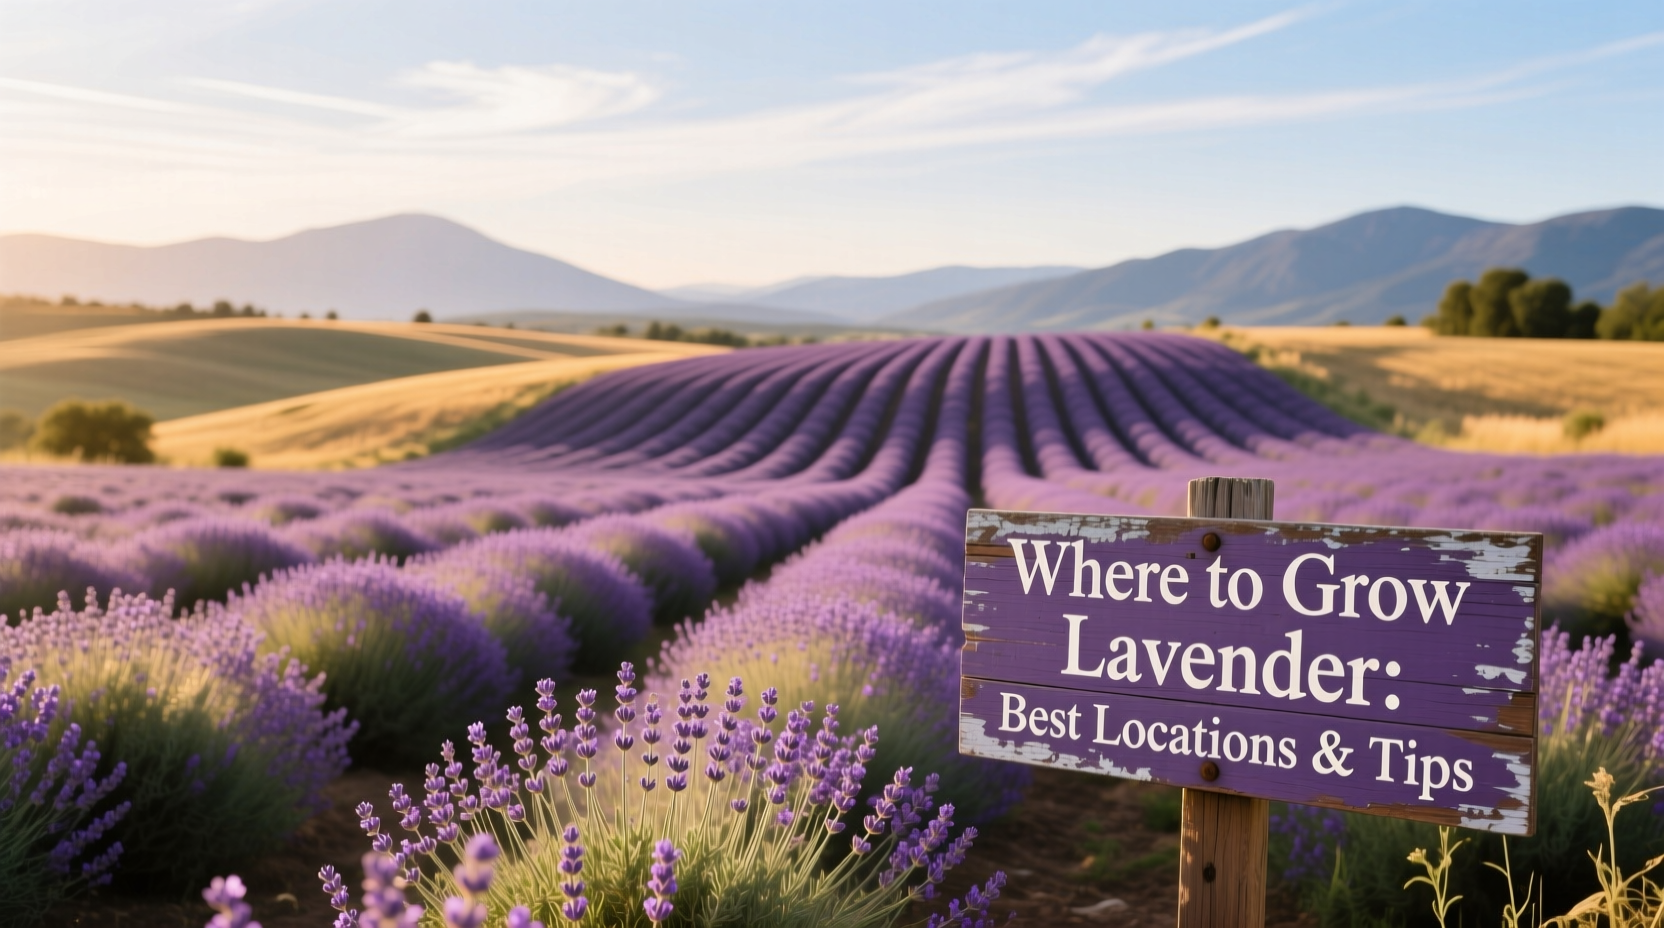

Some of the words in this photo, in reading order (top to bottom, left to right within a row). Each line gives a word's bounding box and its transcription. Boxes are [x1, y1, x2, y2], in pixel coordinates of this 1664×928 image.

[1006, 538, 1189, 605] Where
[1205, 555, 1263, 611] to
[1282, 552, 1471, 626] Grow
[1060, 613, 1401, 710] Lavender:
[998, 692, 1082, 741] Best
[1092, 703, 1297, 769] Locations
[1311, 730, 1354, 777] &
[1369, 736, 1474, 801] Tips
